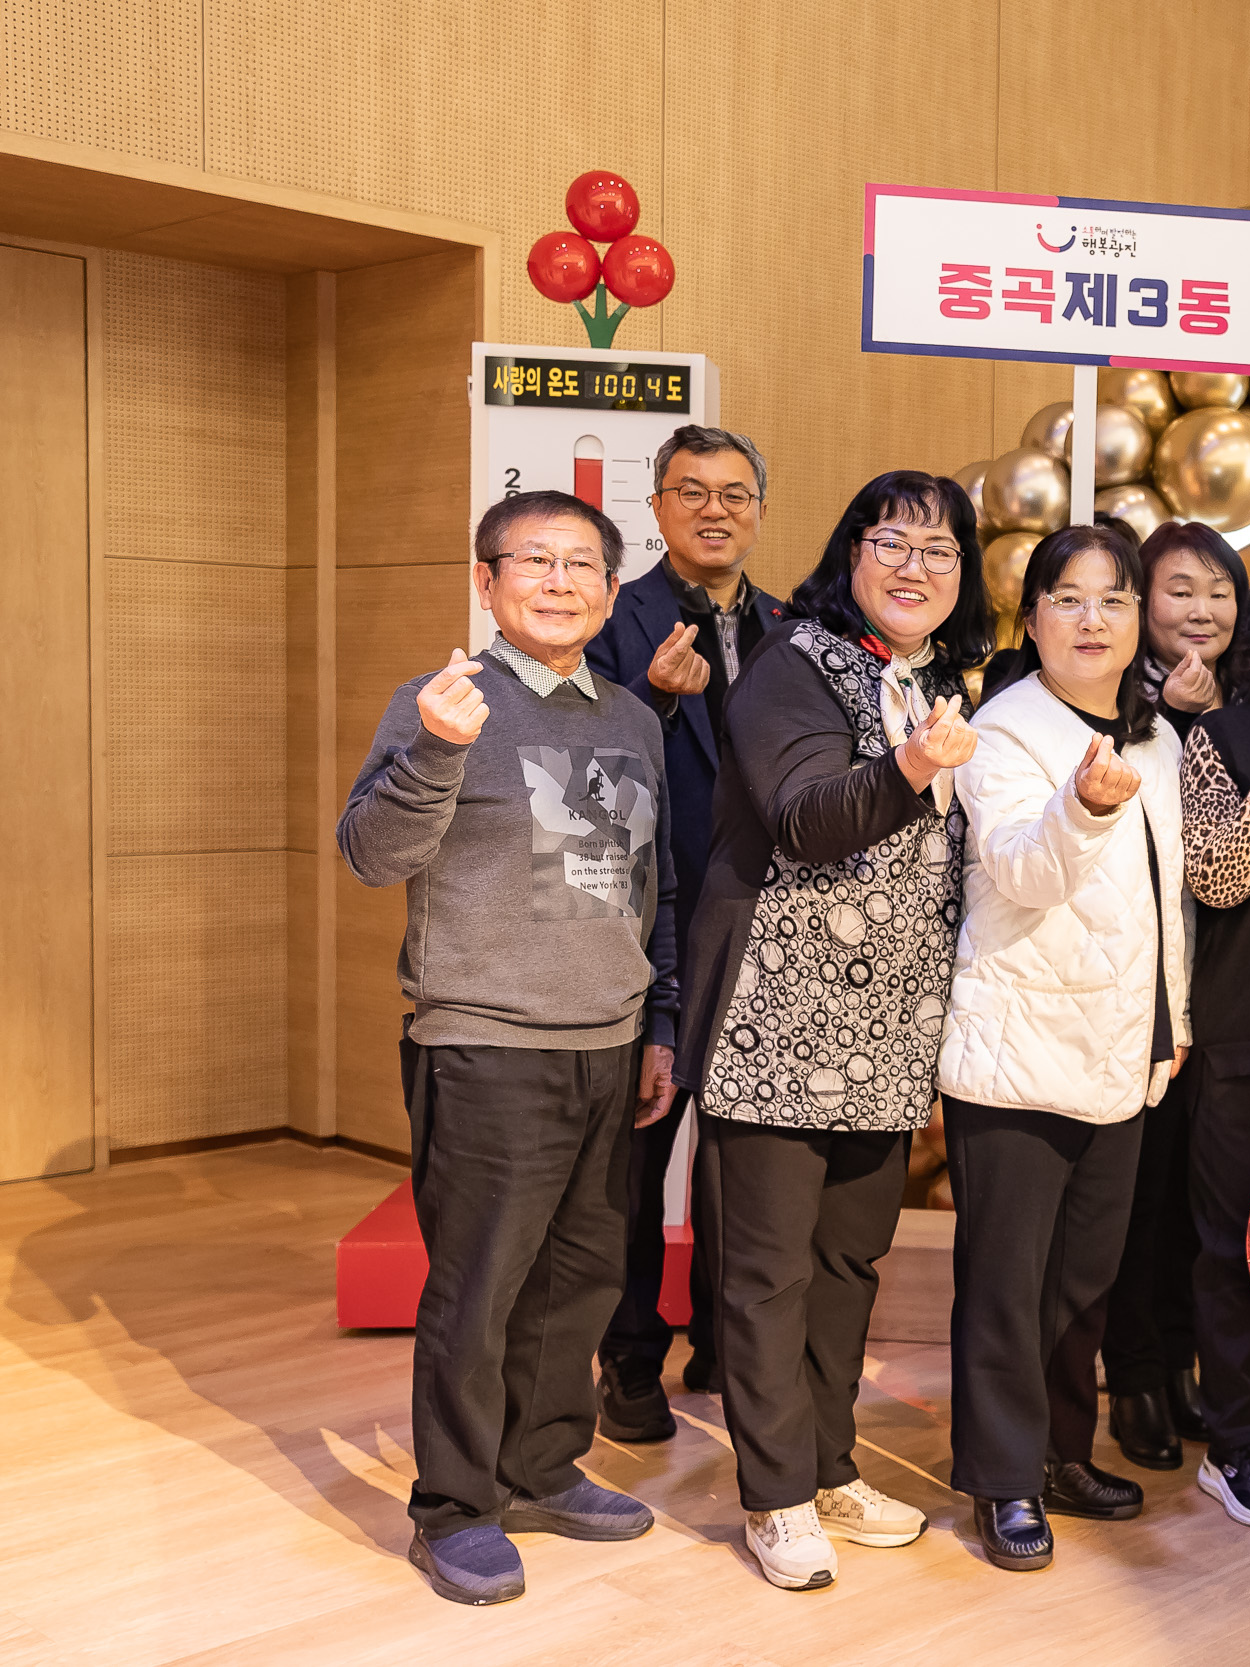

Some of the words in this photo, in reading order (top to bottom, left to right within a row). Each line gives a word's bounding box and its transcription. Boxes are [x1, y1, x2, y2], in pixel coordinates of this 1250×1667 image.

[1082, 238, 1137, 258] 행복광진
[938, 263, 1231, 335] 중곡제3동
[492, 365, 542, 397] 사랑의
[547, 367, 580, 397] 온도
[645, 538, 663, 551] 80
[568, 810, 626, 820] KANGOL
[578, 840, 597, 848] Born
[599, 839, 624, 848] British
[590, 852, 604, 861] but
[606, 852, 628, 861] raised
[580, 882, 598, 890] New
[599, 881, 618, 889] York
